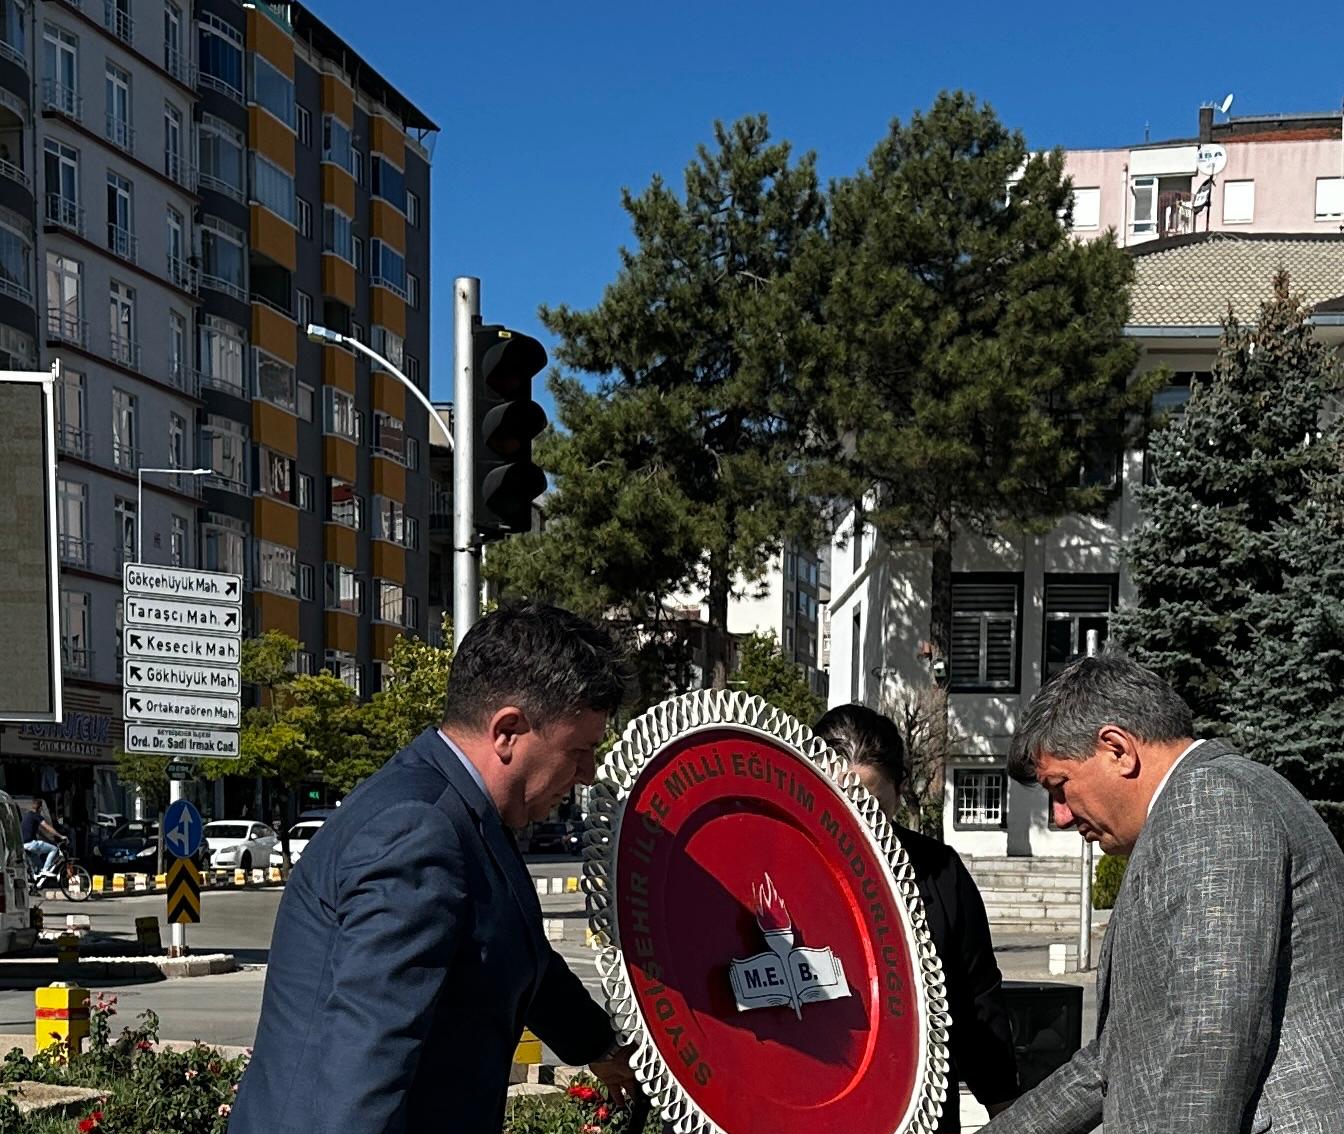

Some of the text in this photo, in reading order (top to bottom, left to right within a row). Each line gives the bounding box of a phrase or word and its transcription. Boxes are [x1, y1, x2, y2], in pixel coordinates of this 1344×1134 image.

[128, 570, 220, 593] Gökçehüyük Mah.
[187, 610, 220, 625] Mah.
[147, 636, 238, 658] Kesecik Mah.
[147, 667, 237, 687] Gökhüyük Mah.
[147, 700, 237, 719] Ortakaraören Mah.
[131, 735, 236, 752] Ord. Dr. Sadi Irmak Cad.
[664, 748, 725, 800] MİLLİ
[730, 751, 816, 813] EĞİTİM
[635, 791, 672, 863] İLÇE
[625, 871, 713, 1086] SEYDİŞEHİR
[743, 962, 819, 989] M.E. B.
